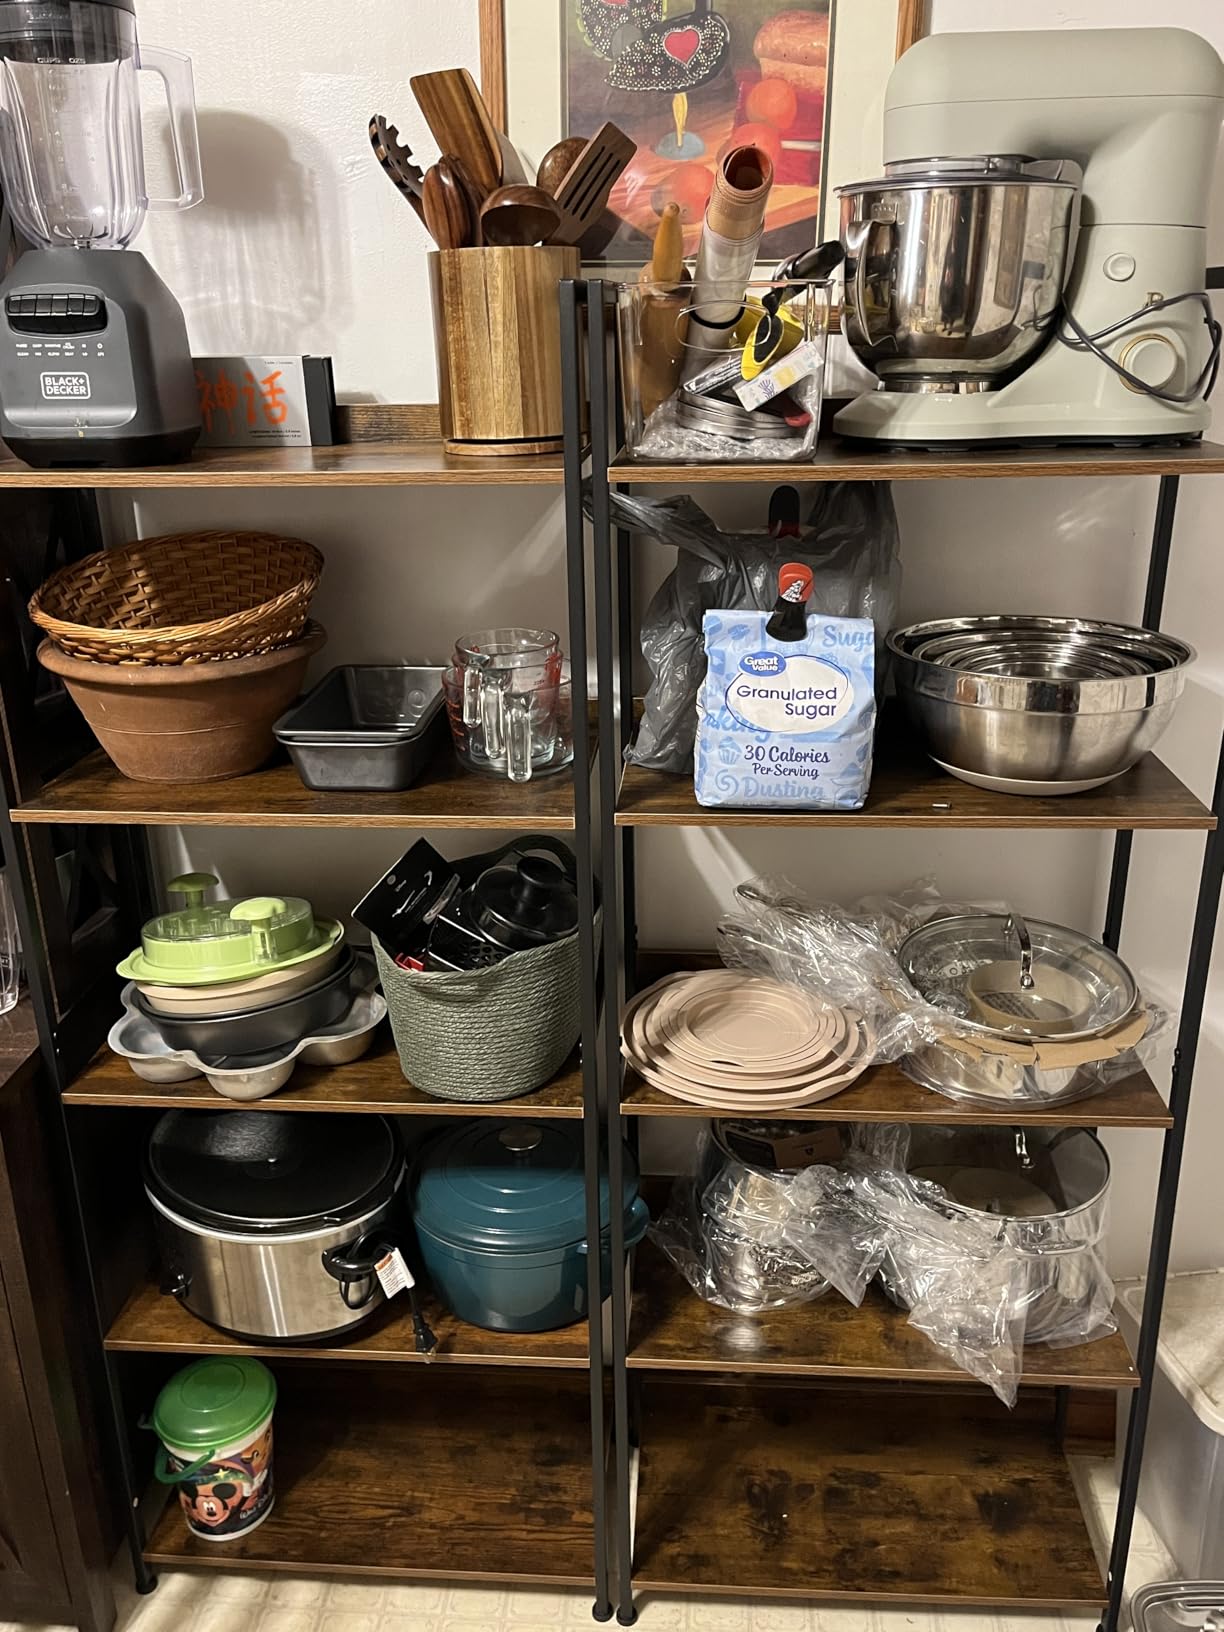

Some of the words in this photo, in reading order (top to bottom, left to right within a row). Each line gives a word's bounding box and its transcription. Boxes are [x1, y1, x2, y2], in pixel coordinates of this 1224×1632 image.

[45, 376, 85, 386] BLACK+
[46, 385, 87, 395] DECKER
[744, 656, 778, 667] Great
[736, 685, 837, 701] Granulated
[784, 703, 837, 720] Sugar
[744, 745, 766, 761] 30
[768, 745, 831, 763] Calories
[751, 762, 773, 775] Per
[773, 763, 820, 780] Serving
[741, 776, 824, 799] Dusting
